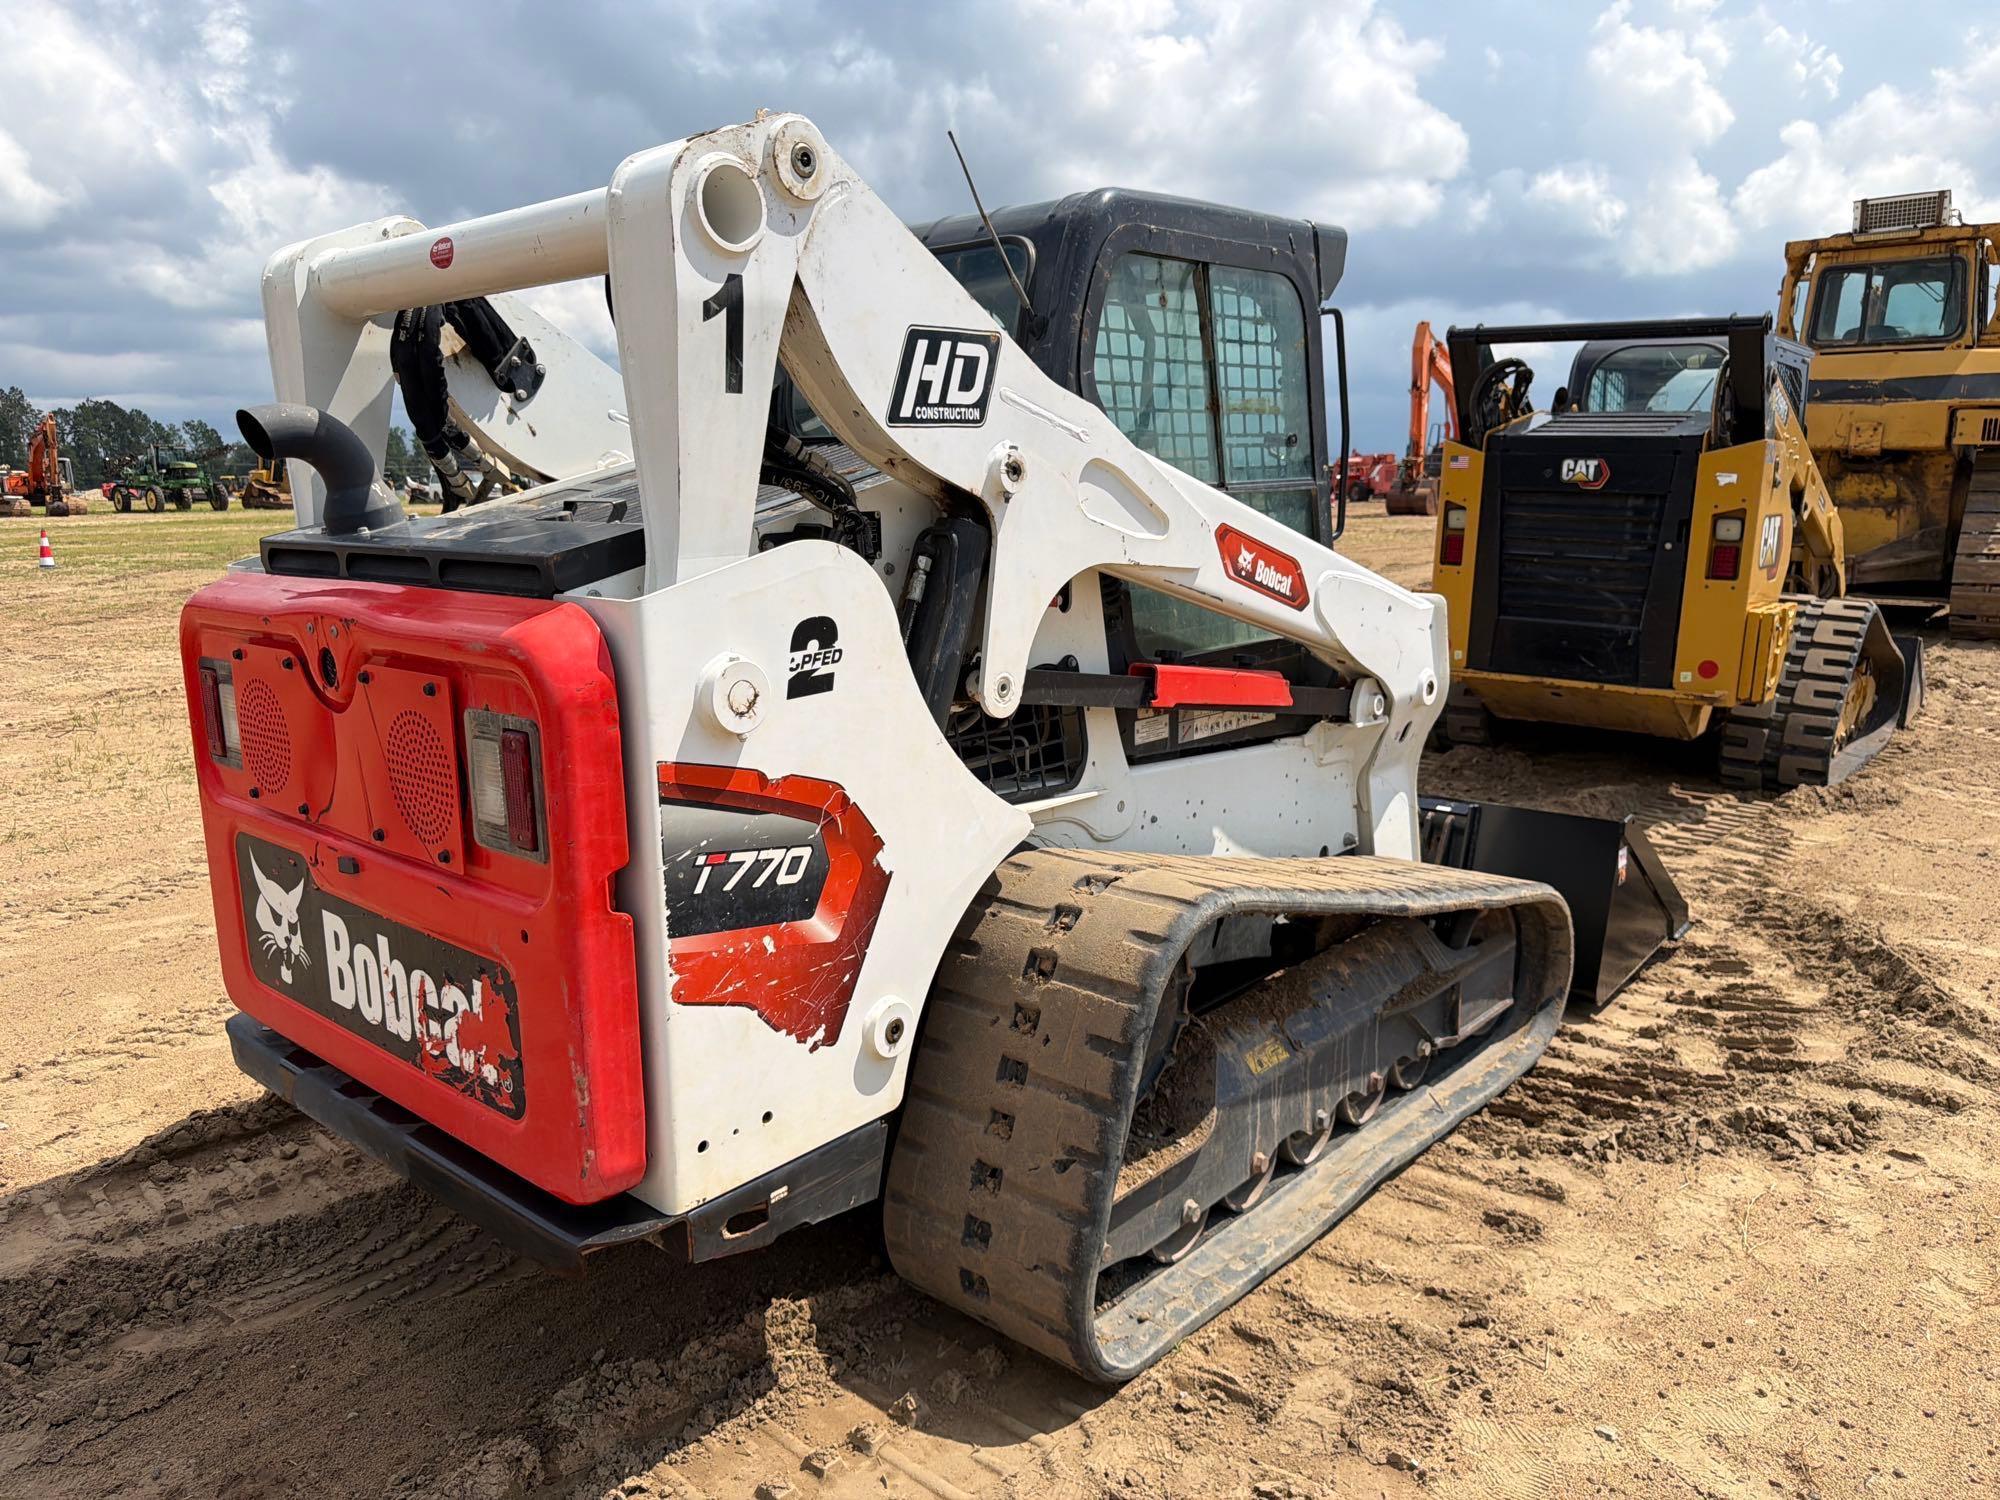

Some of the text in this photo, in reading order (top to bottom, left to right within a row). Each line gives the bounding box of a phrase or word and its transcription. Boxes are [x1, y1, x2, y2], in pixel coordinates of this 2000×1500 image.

[703, 273, 743, 394] 1
[900, 339, 989, 417] HD
[915, 406, 980, 420] CONSTRUCTION
[1561, 459, 1598, 482] CAT
[1759, 515, 1781, 568] CAT
[1255, 559, 1293, 596] Bobcat
[787, 615, 839, 700] 2
[693, 846, 813, 895] T770
